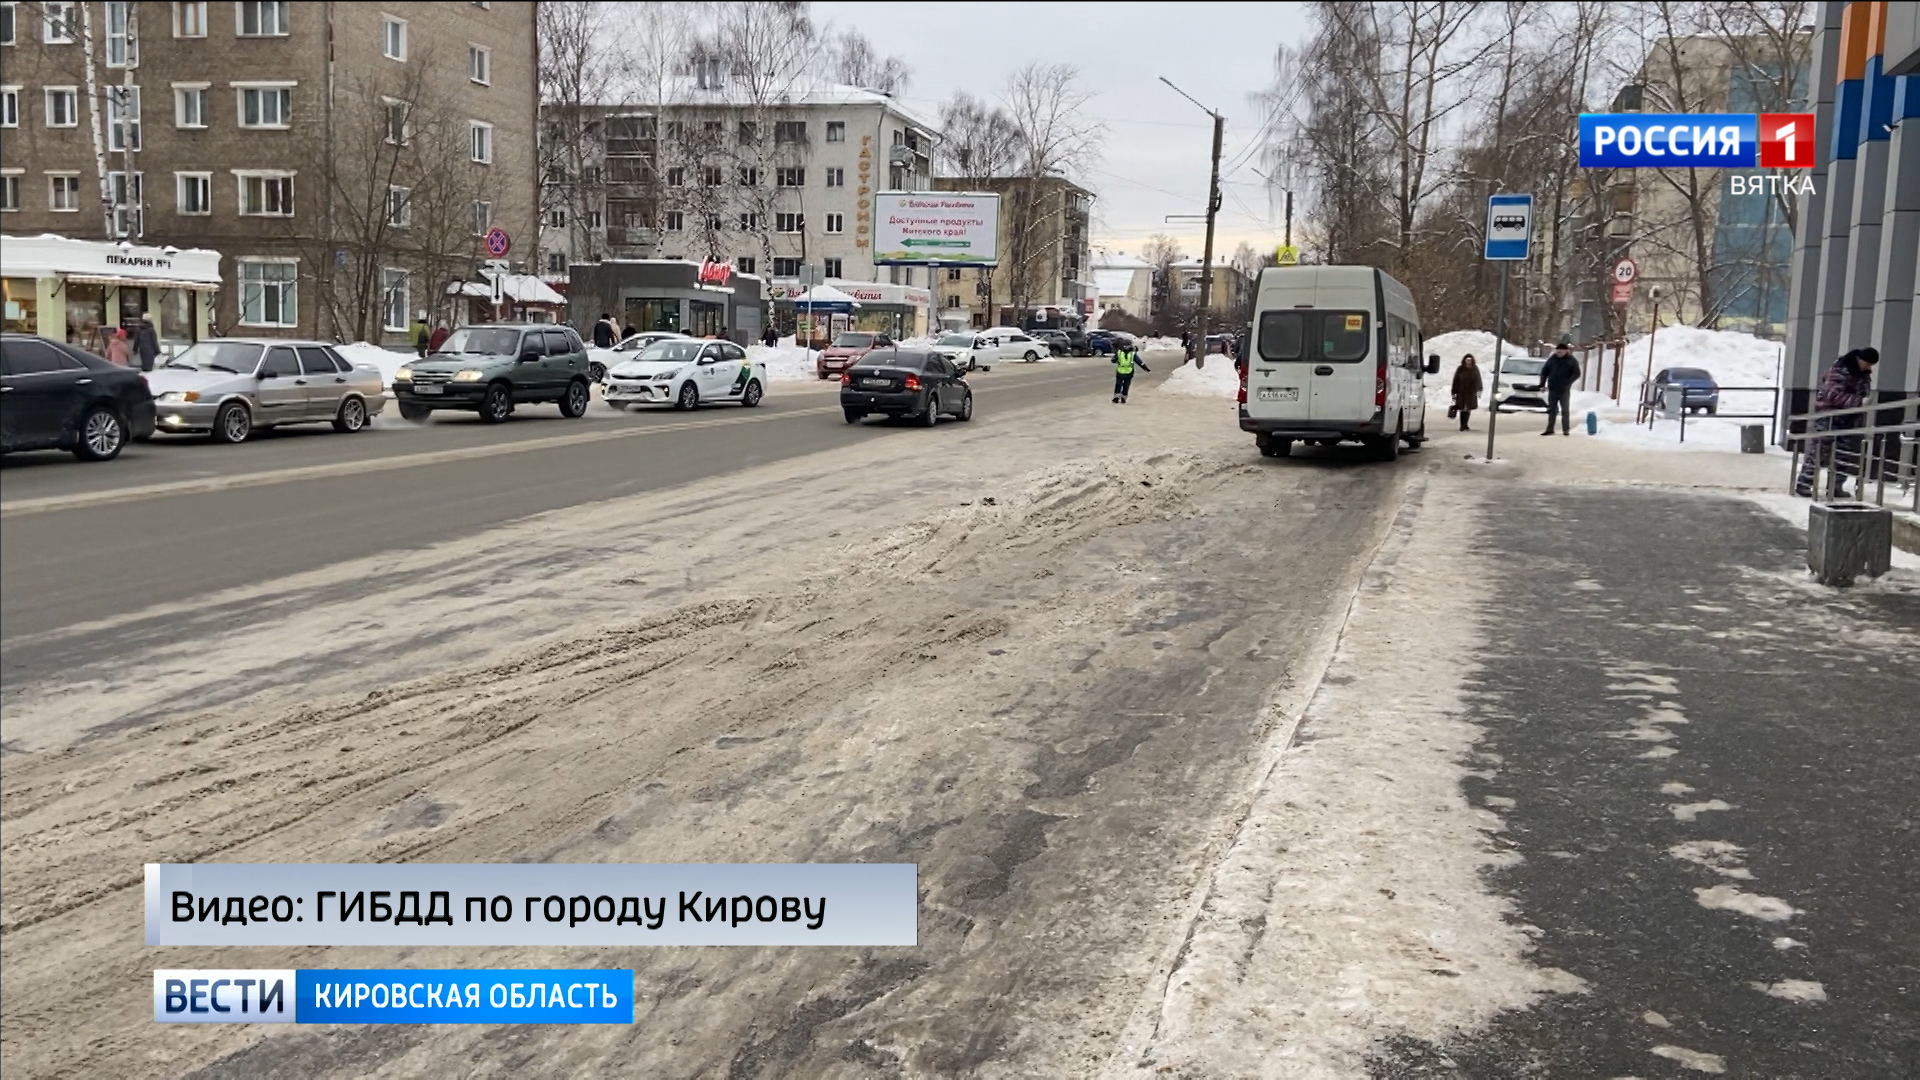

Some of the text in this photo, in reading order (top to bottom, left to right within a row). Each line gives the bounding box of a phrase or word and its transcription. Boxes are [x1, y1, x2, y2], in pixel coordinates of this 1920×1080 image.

[857, 135, 872, 248] ГАСТРОНОМ
[889, 215, 984, 228] Доступные продукты
[106, 255, 153, 267] ПЕКАРНЯ
[1619, 266, 1632, 276] 20
